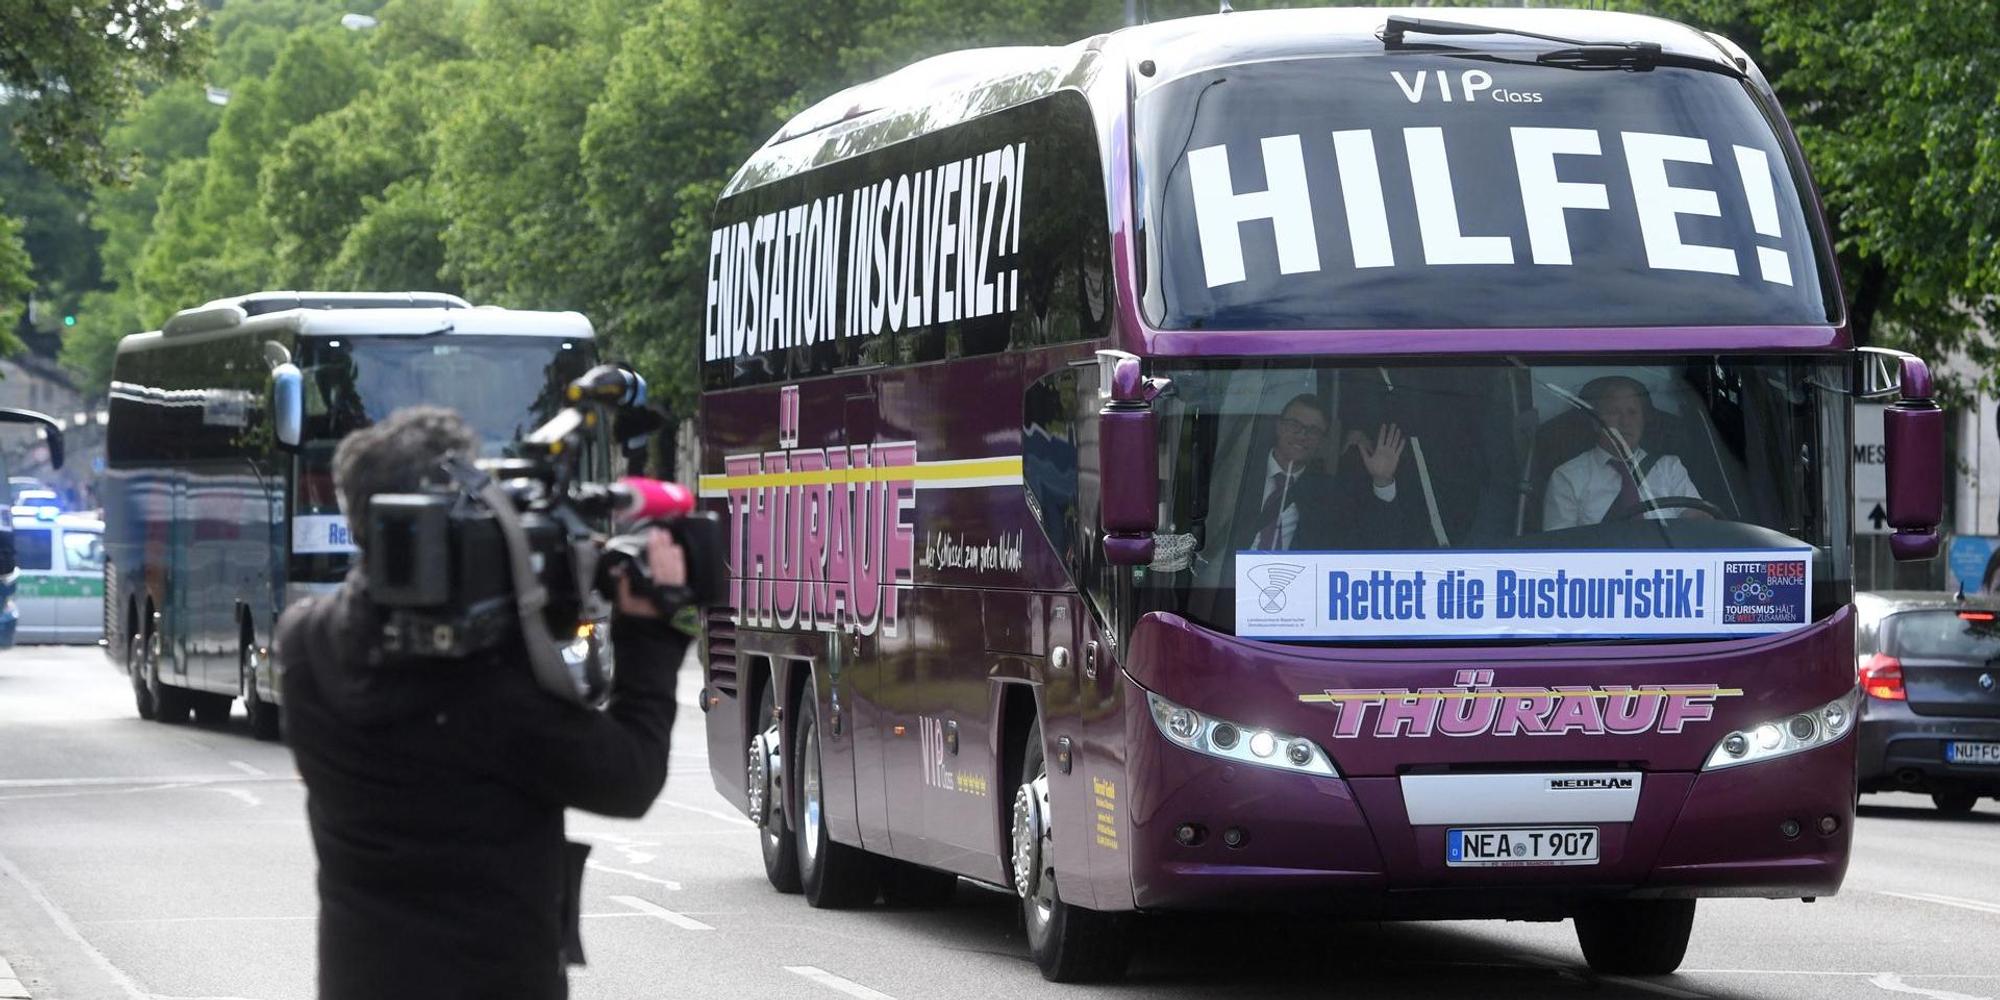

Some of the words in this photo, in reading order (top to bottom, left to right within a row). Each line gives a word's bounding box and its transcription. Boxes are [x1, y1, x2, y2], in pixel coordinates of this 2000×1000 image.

[1390, 69, 1493, 104] VIP
[1491, 89, 1543, 103] Class
[1187, 126, 1794, 287] HILFE!
[706, 194, 845, 362] ENDSTATION
[845, 142, 1027, 336] INSOLVENZ?!
[724, 385, 917, 637] THÜRAUF
[1726, 563, 1760, 573] RETTET
[1767, 562, 1804, 577] REISE
[1767, 576, 1804, 586] BRANCHE
[1328, 570, 1426, 621] Rettet
[1436, 571, 1485, 620] die
[1496, 569, 1705, 620] Bustouristik!
[1726, 605, 1774, 614] TOURISMUS
[1757, 614, 1796, 622] ZUSAMMEN
[1326, 669, 1719, 738] THÜRAUF
[919, 715, 944, 787] VIP
[1551, 778, 1632, 790] NEOPLAN
[1463, 834, 1512, 858] NEA
[1528, 834, 1544, 857] T
[1550, 832, 1594, 857] 907
